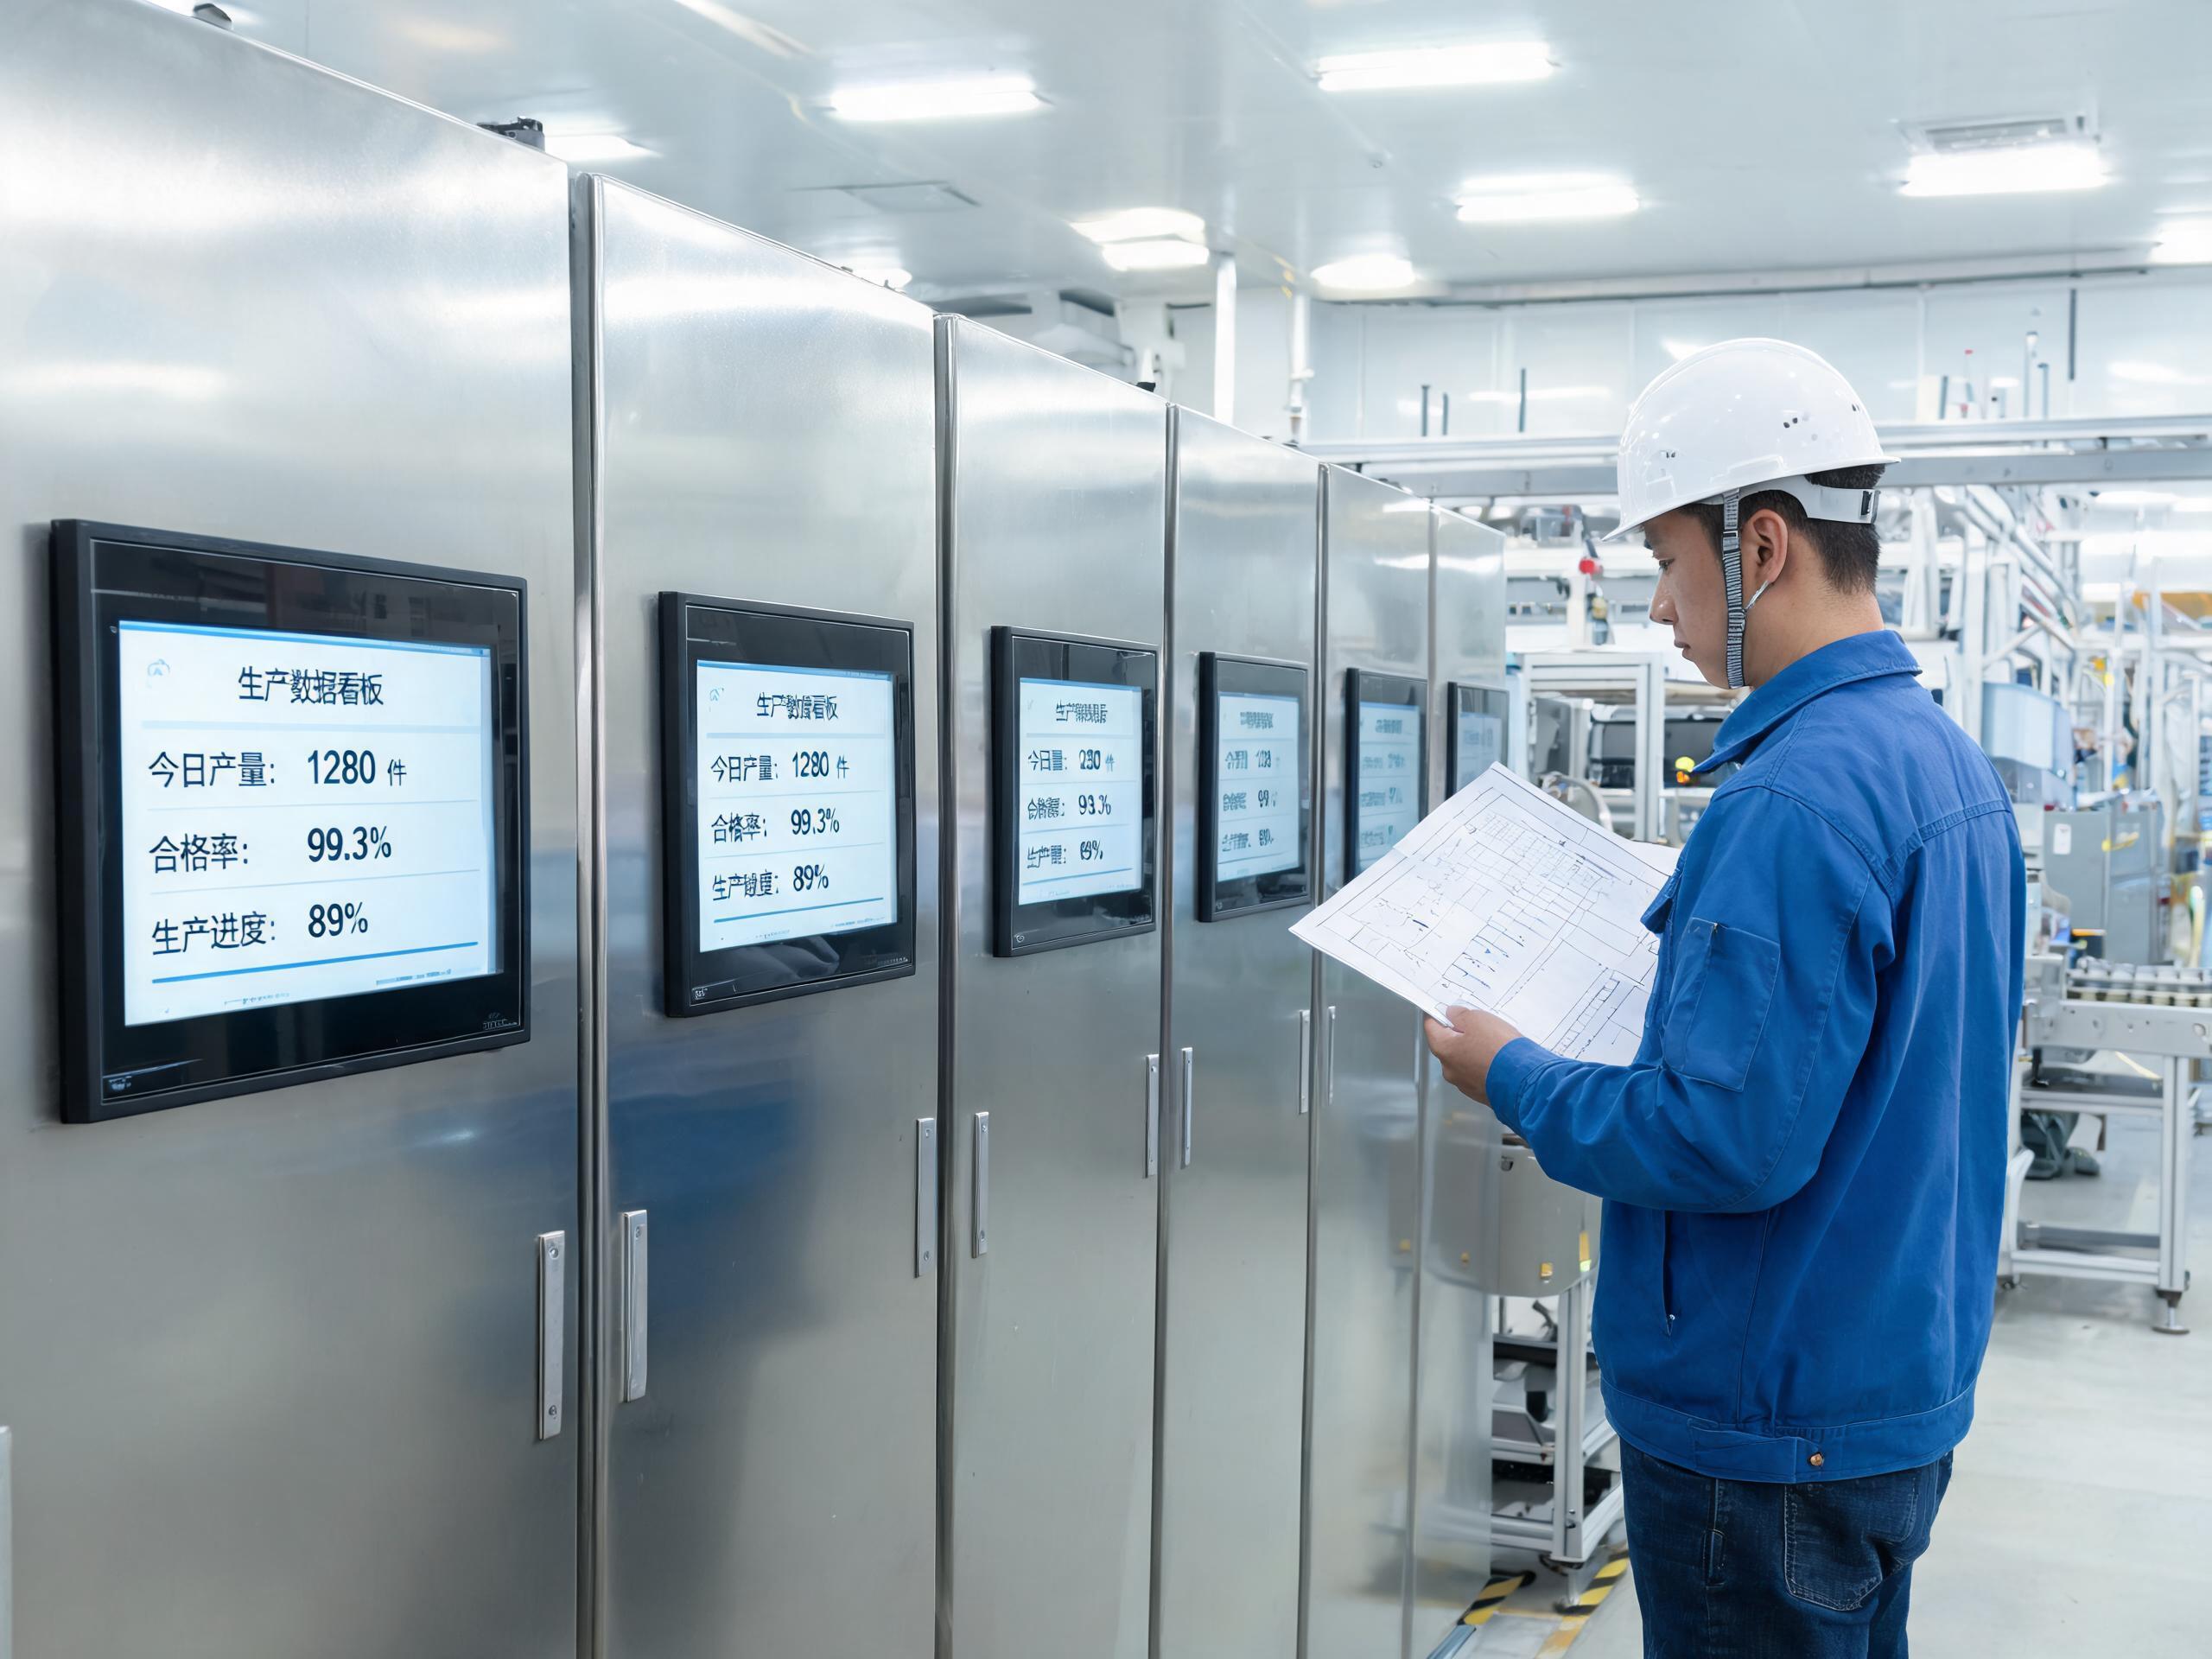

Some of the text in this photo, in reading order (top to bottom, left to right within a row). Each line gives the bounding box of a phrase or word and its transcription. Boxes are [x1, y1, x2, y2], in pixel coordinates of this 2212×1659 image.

[238, 666, 384, 705] 生产数据看板
[149, 750, 407, 787] 今日产量： 1280 件
[792, 751, 829, 777] 1280
[791, 808, 839, 835] 99.3%
[149, 826, 391, 874] 合格率： 99.3%
[793, 865, 829, 892] 89%
[152, 902, 368, 955] 生产进度： 89%
